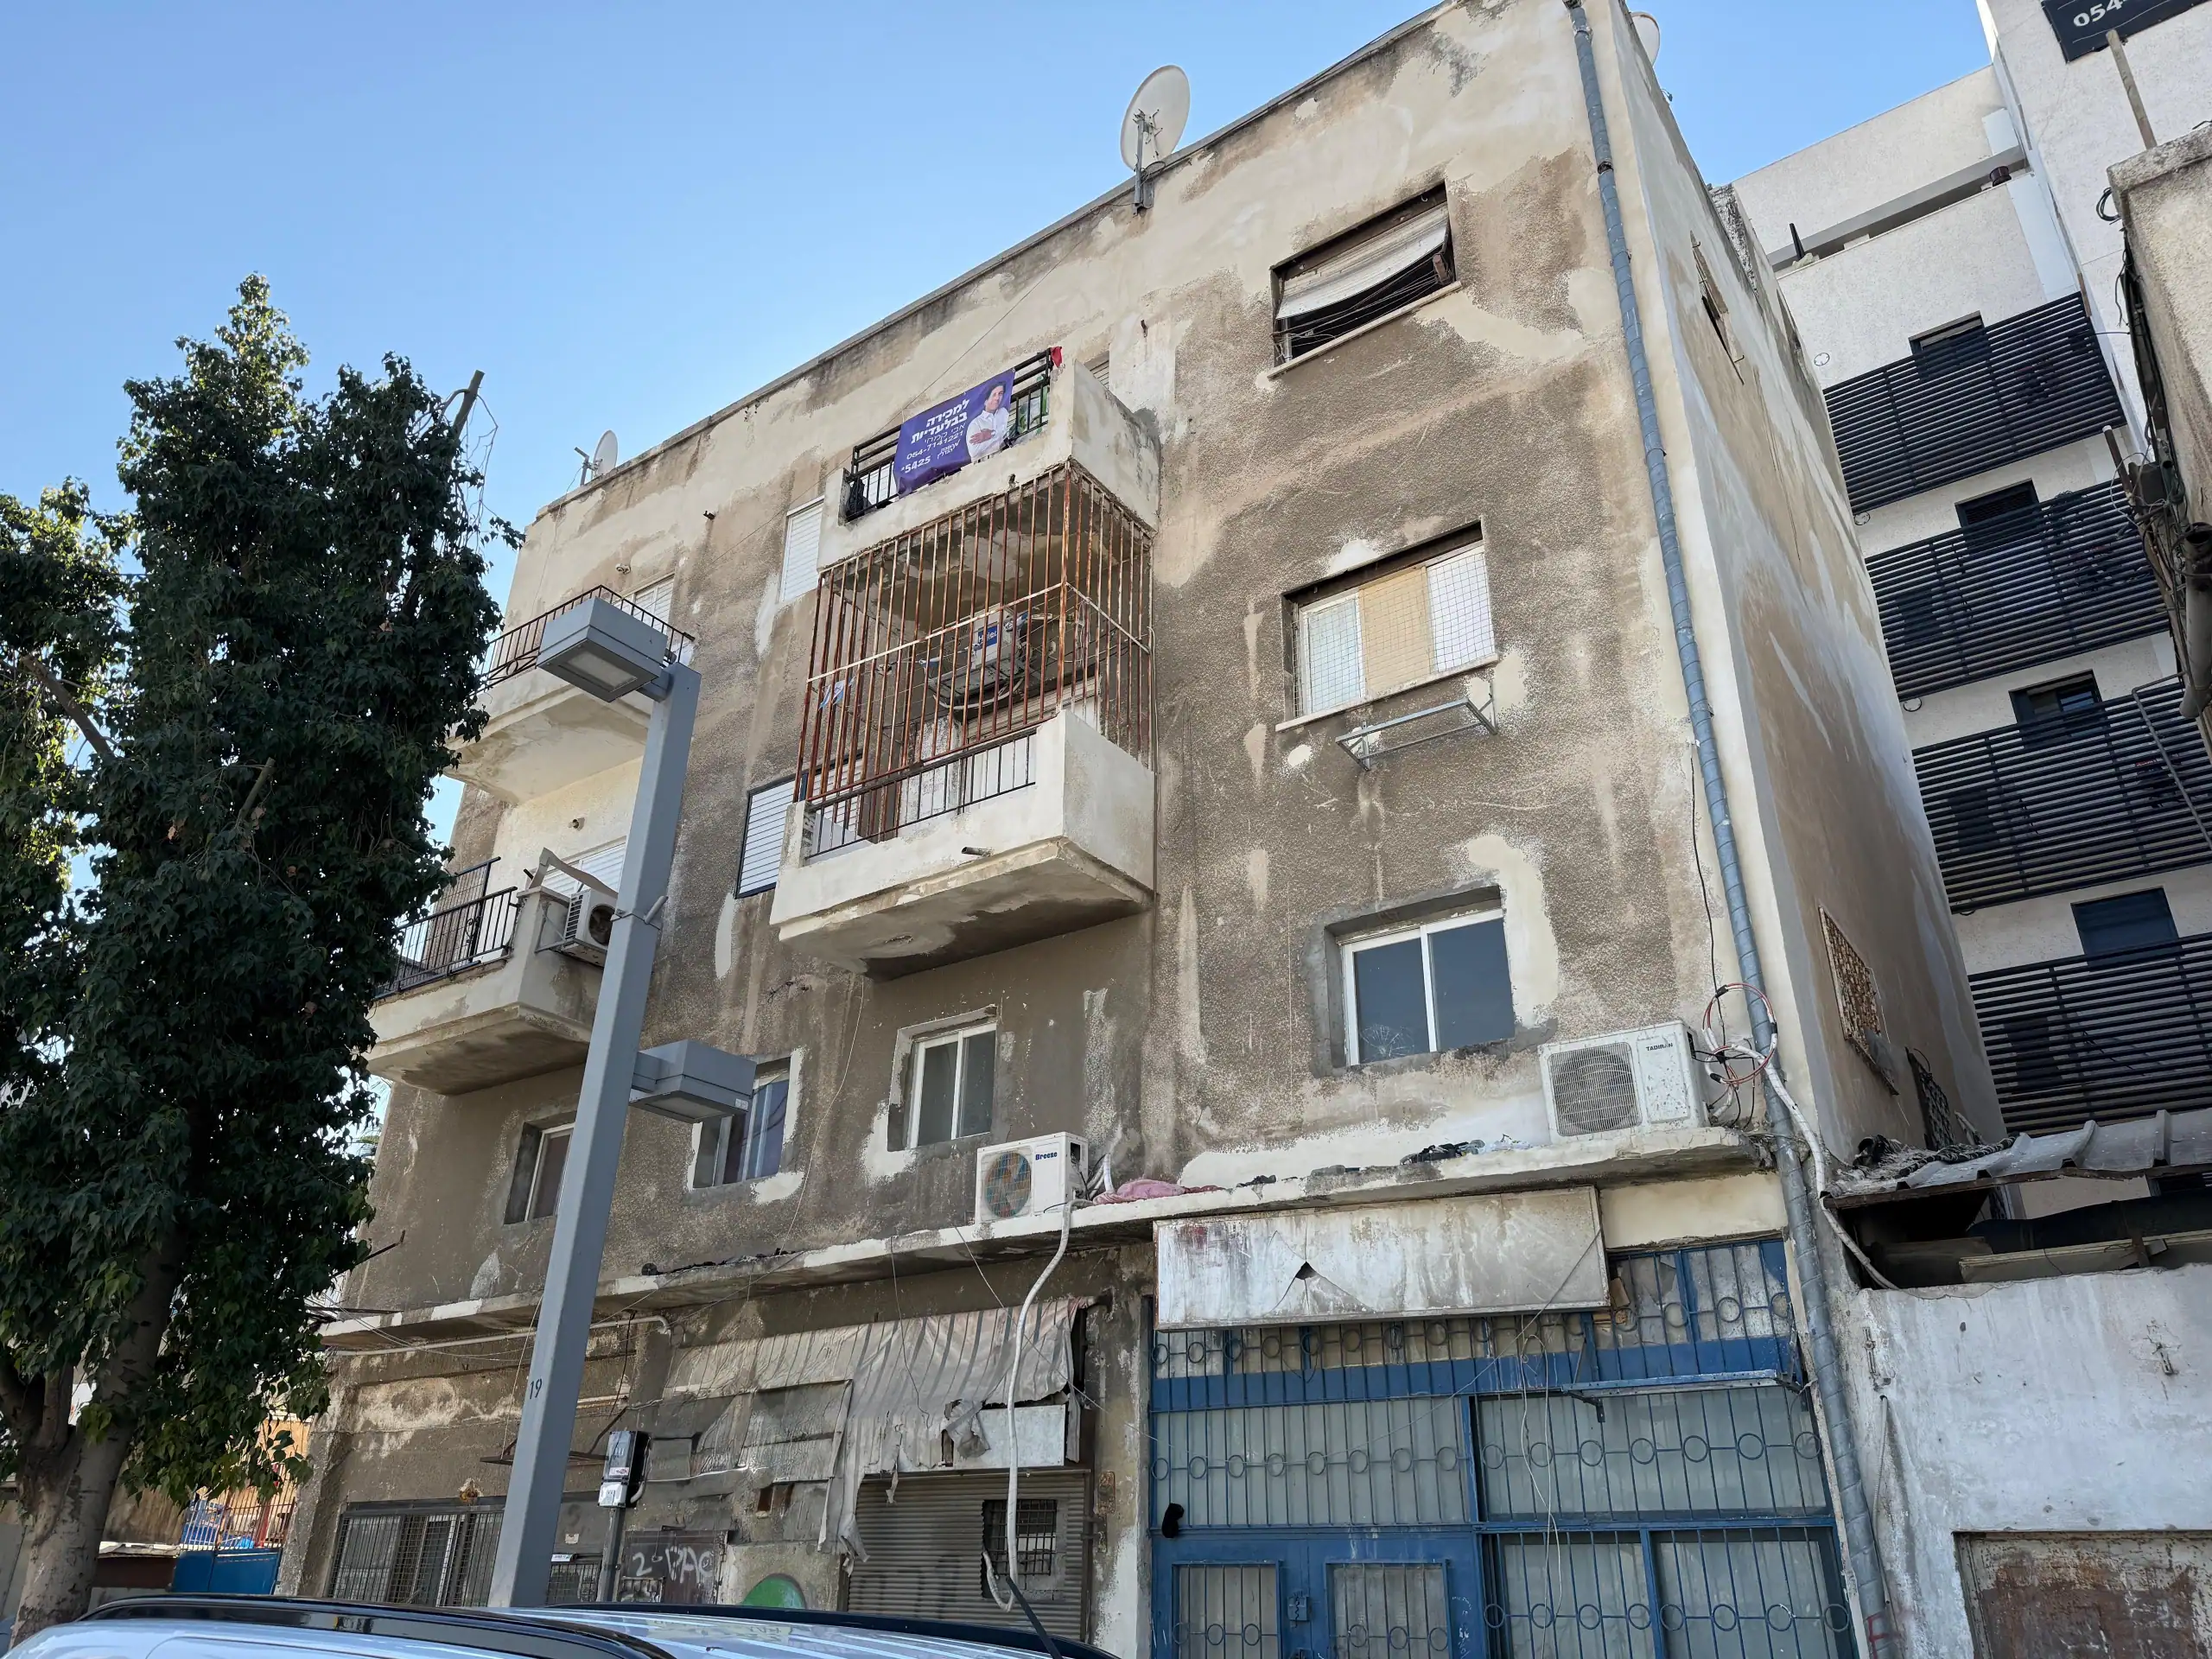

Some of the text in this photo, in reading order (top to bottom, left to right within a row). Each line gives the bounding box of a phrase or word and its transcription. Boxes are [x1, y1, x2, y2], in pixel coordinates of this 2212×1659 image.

[925, 398, 969, 427] למכירה
[911, 411, 968, 444] בבלעדיות
[978, 631, 997, 643] Hier
[1646, 1043, 1673, 1052] TADIRAN
[1035, 1151, 1058, 1160] Breeze
[530, 1378, 543, 1400] 19
